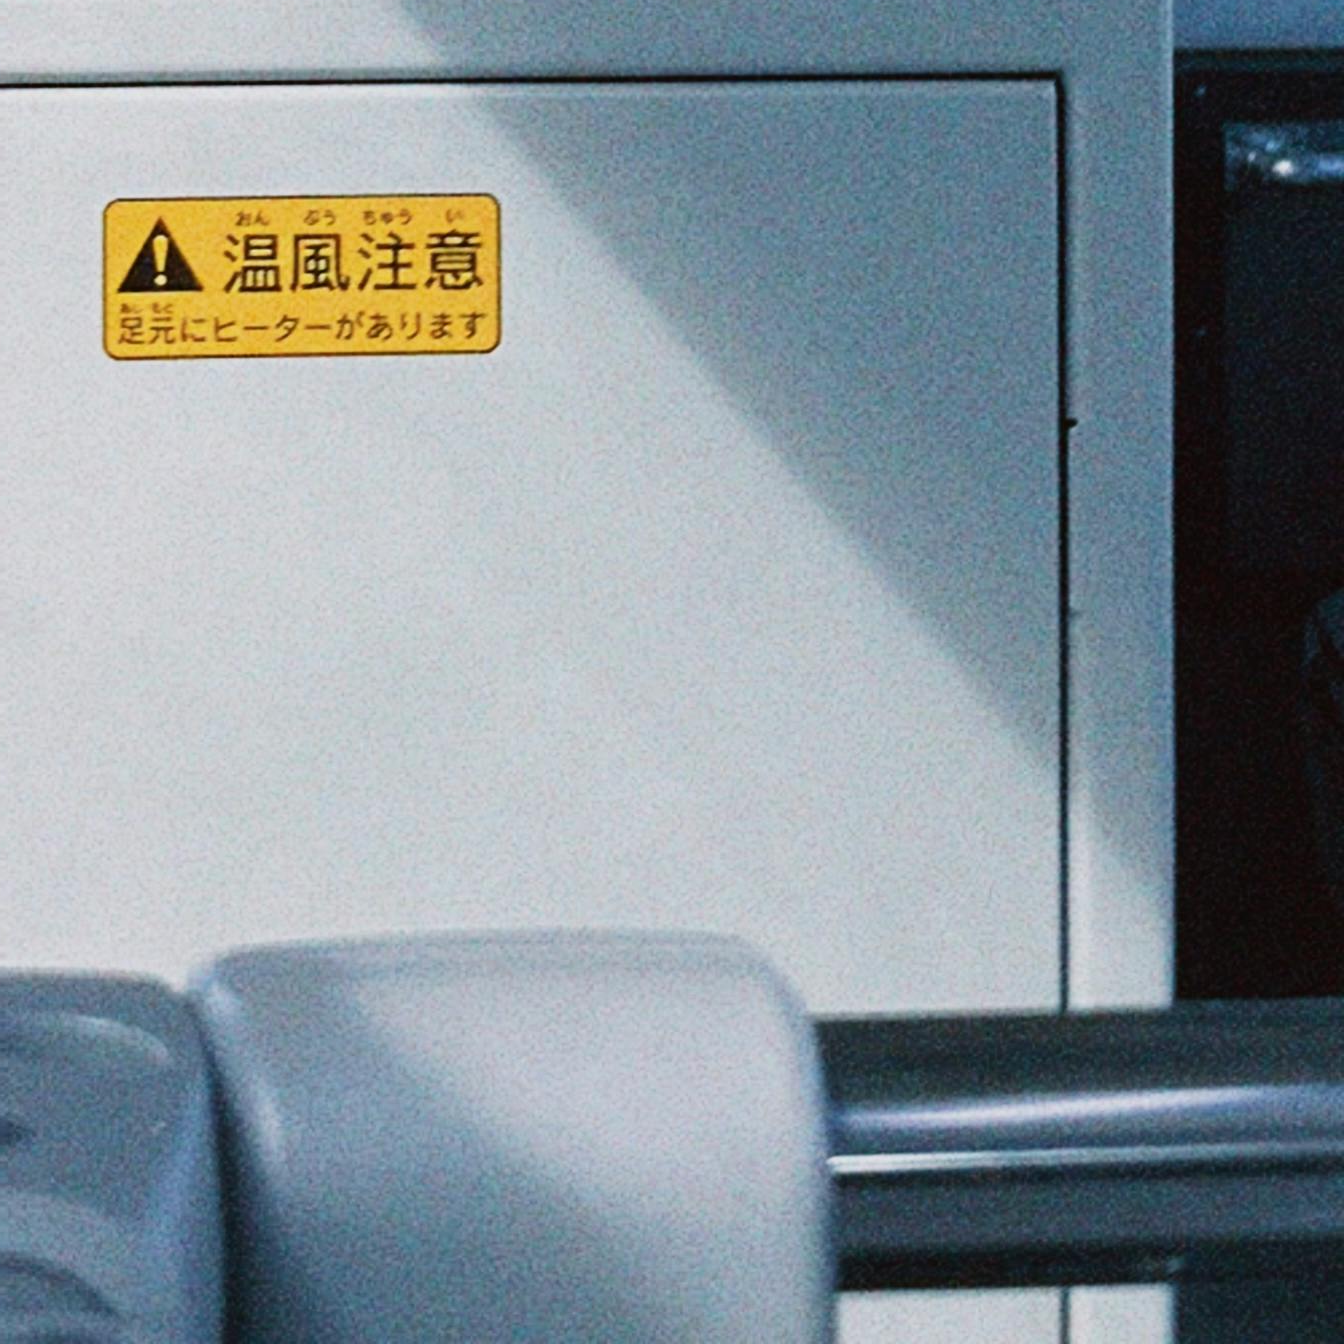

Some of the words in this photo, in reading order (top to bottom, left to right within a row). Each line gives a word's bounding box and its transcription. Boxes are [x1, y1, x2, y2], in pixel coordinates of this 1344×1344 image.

[223, 229, 484, 293] 温風注意
[117, 310, 488, 345] 足元にヒーターがあります
